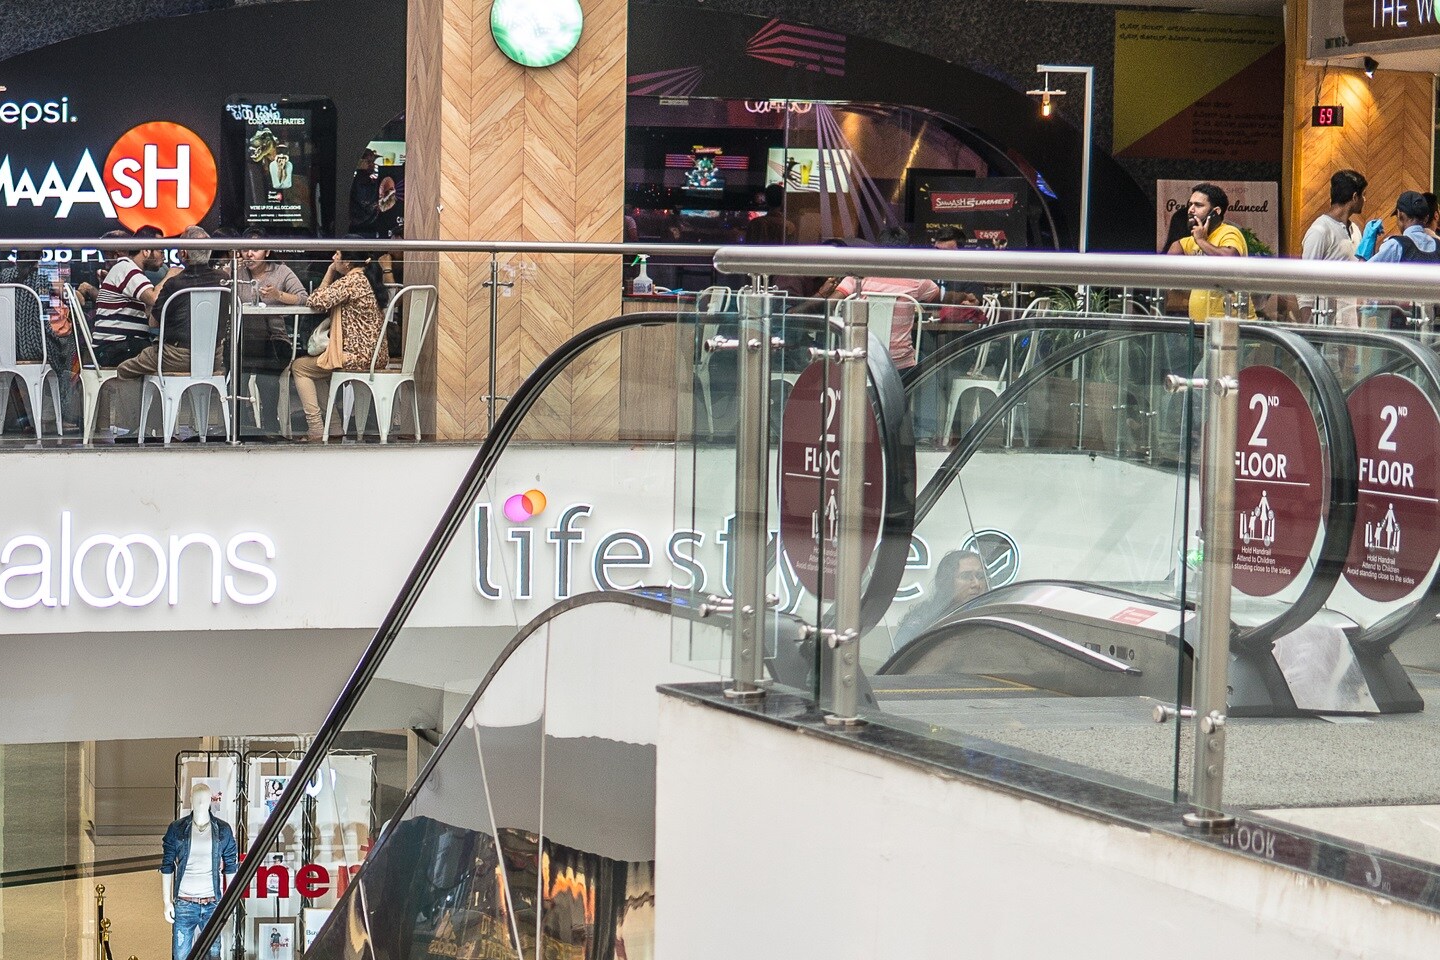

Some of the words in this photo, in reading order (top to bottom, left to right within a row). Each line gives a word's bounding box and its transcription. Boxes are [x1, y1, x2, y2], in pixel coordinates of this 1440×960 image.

[248, 118, 283, 126] CORPORATE
[283, 118, 306, 126] PARTIES
[1319, 107, 1333, 125] 69
[1227, 200, 1268, 212] alanced
[805, 446, 841, 476] FLOO
[1358, 457, 1414, 488] FLOOR
[1241, 546, 1252, 554] Hold
[1252, 547, 1272, 555] Handrail
[1236, 554, 1251, 562] Attend
[1257, 555, 1276, 564] Children
[1366, 554, 1377, 562] Hold
[1378, 555, 1396, 565] Handrail
[1234, 562, 1253, 572] standing
[1279, 567, 1291, 575] sides
[1361, 561, 1376, 570] Attend
[1382, 564, 1400, 573] Children
[1346, 567, 1359, 575] Avoid
[1359, 570, 1377, 580] standing
[1403, 577, 1415, 585] sides
